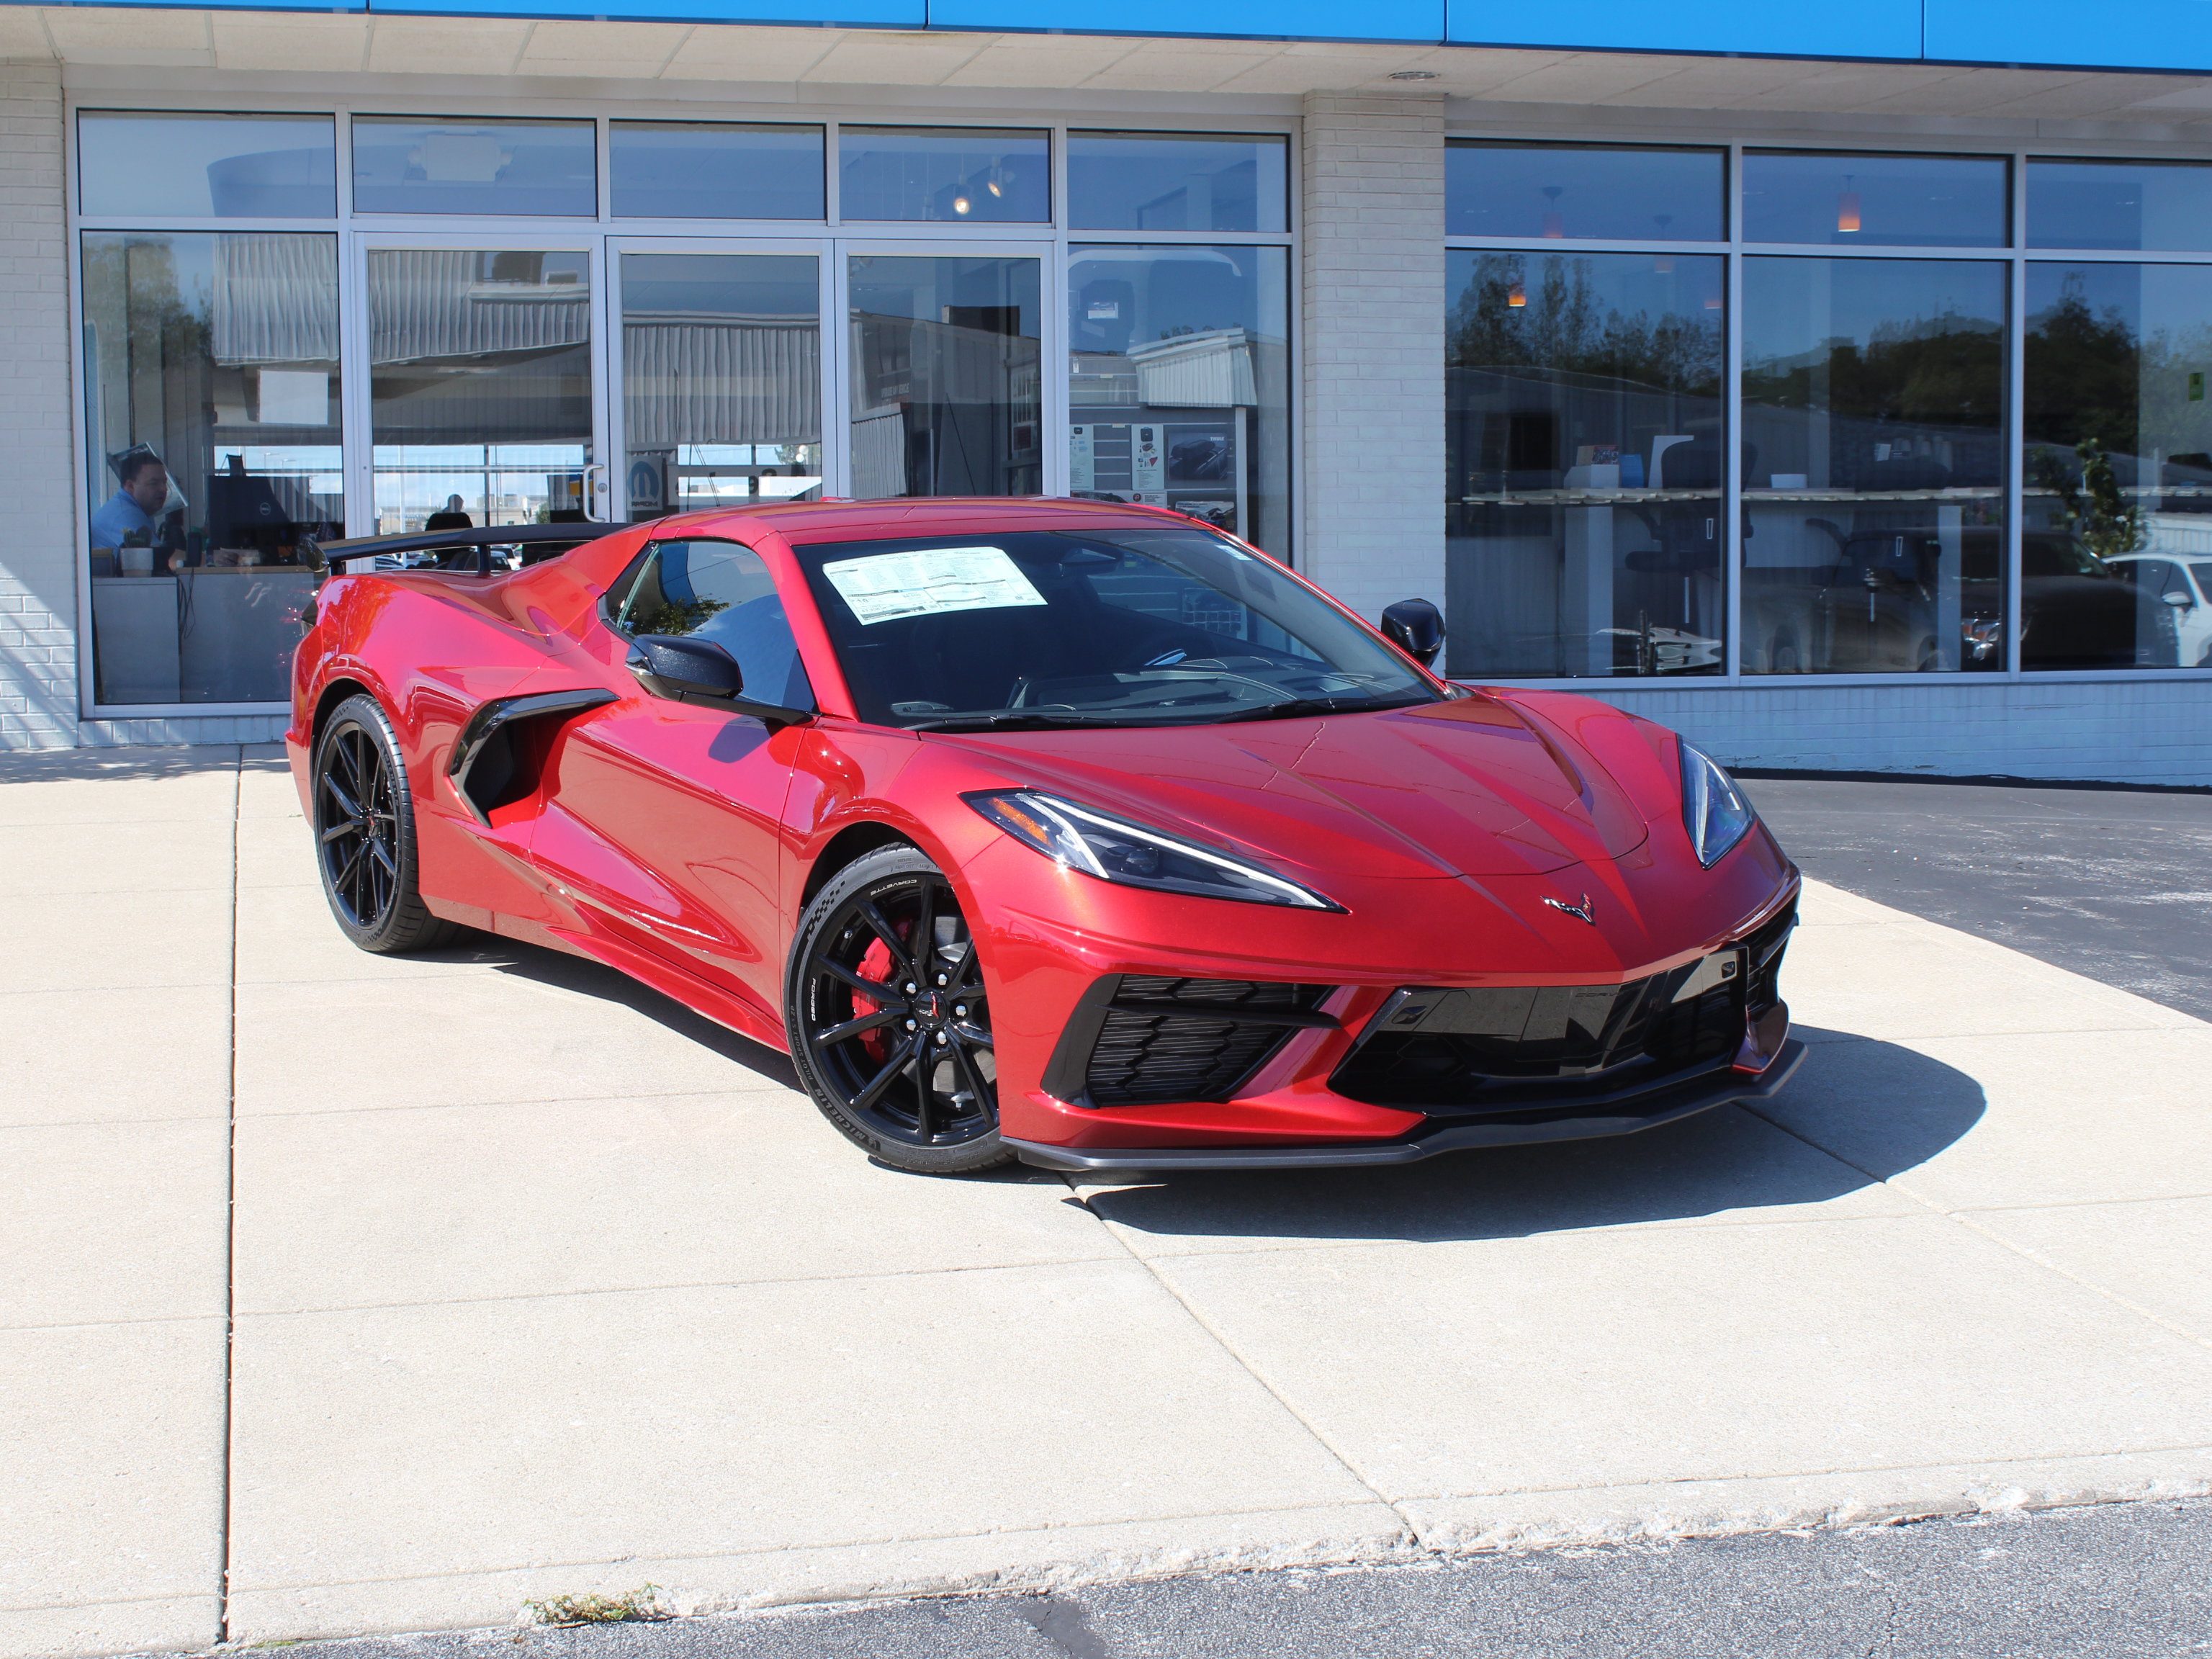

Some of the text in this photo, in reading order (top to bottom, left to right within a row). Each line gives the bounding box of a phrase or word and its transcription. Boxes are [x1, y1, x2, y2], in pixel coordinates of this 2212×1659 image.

[870, 879, 917, 896] CORVETTE
[793, 1030, 804, 1056] SPORT
[801, 1057, 814, 1080] PILOT
[814, 1088, 866, 1141] MICHELIN
